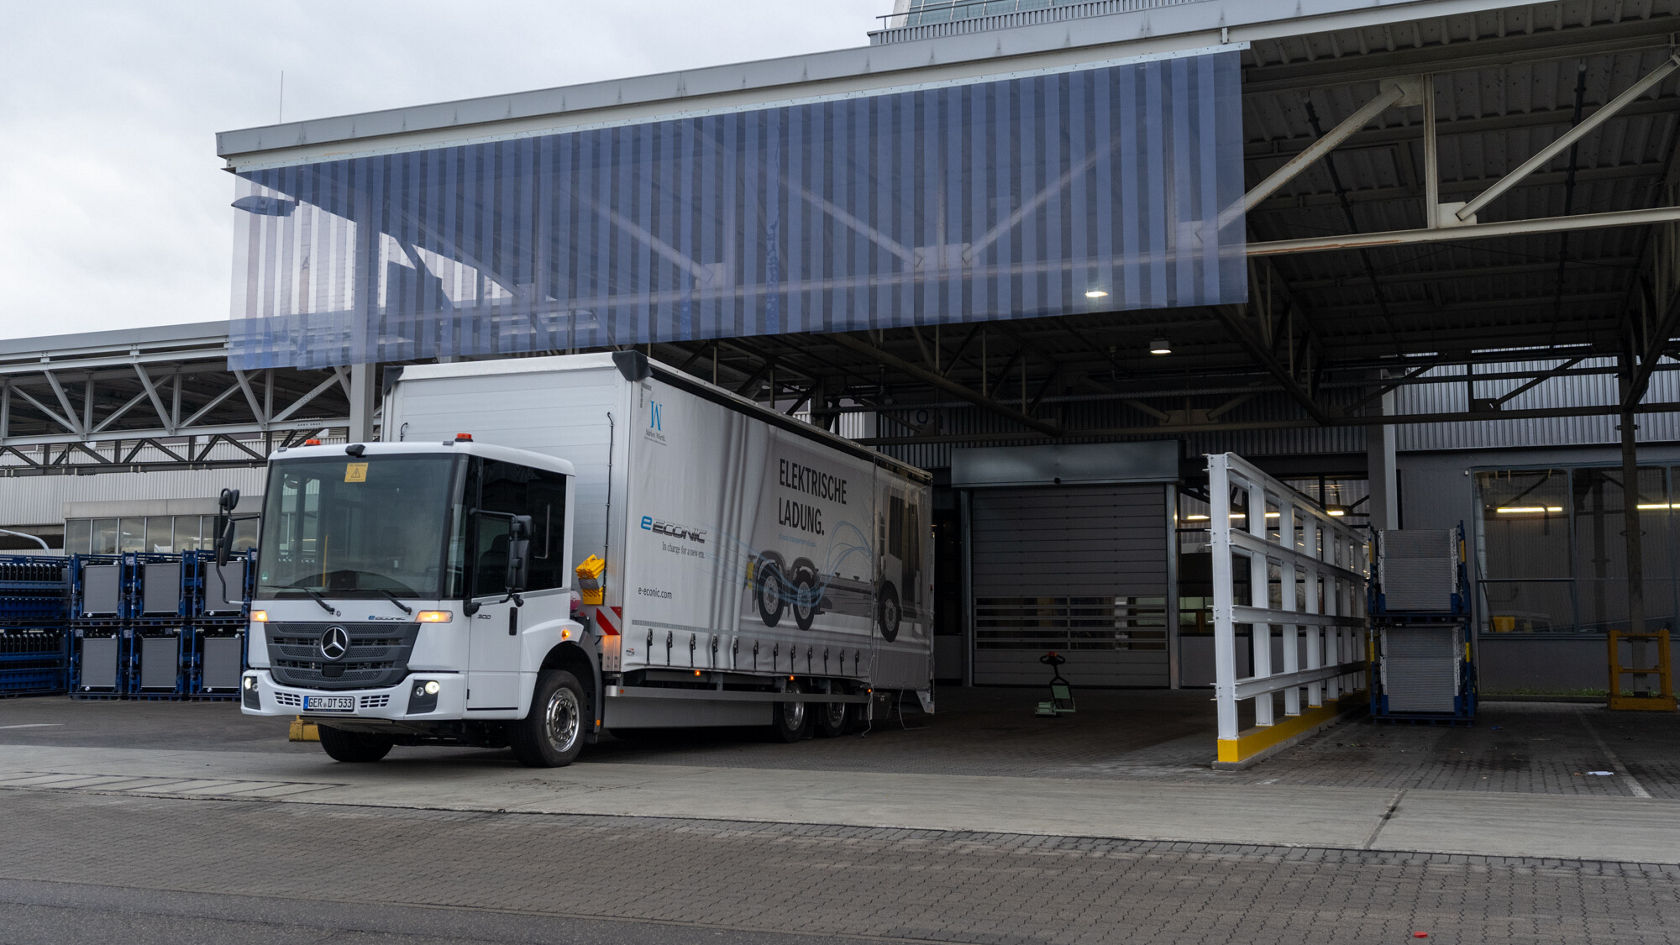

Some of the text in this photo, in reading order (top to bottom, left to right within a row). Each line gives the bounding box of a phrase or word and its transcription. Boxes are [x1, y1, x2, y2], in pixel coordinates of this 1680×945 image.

[779, 458, 847, 505] ELEKTRISCHE
[778, 497, 825, 536] LADUNG.
[637, 586, 673, 600] e-econic.com
[308, 697, 353, 708] GER DT 533
